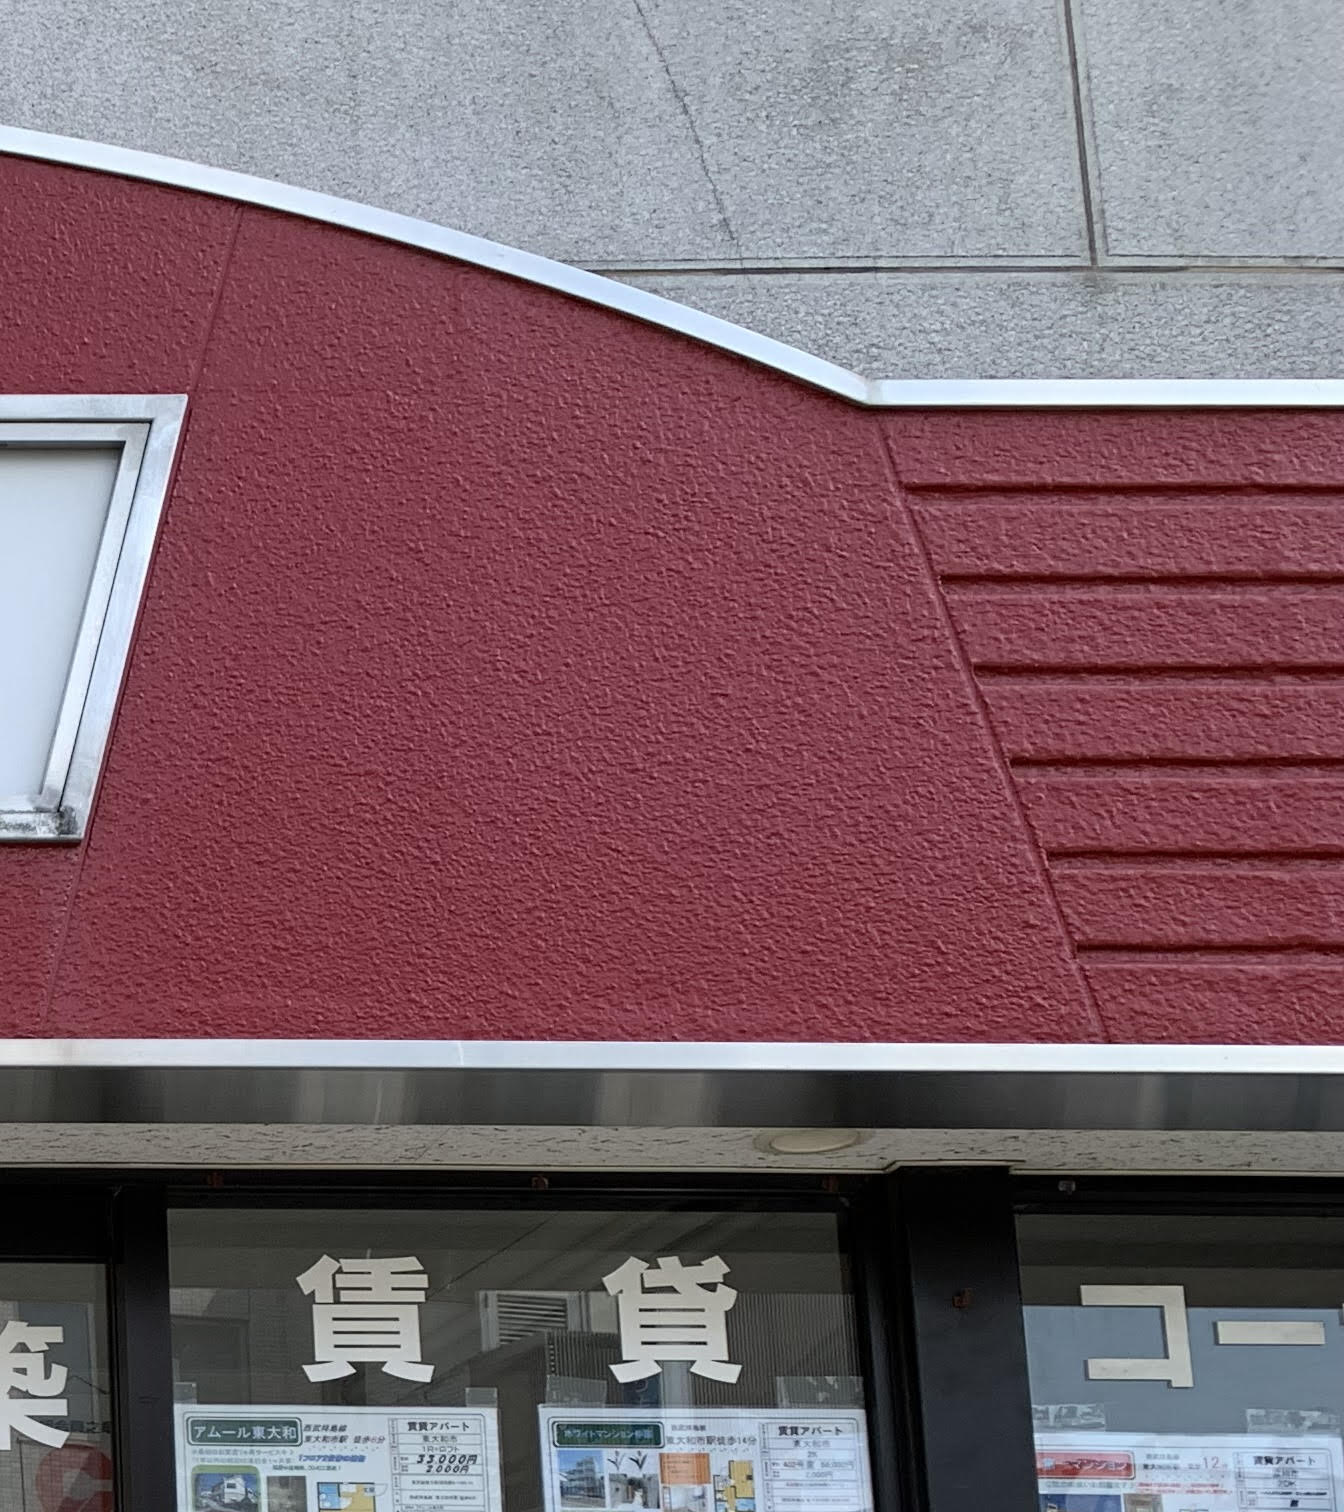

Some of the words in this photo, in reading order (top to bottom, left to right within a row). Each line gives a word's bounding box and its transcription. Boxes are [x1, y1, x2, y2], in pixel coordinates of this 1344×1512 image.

[1080, 1284, 1344, 1388] コー
[193, 1425, 298, 1440] アムール東大和
